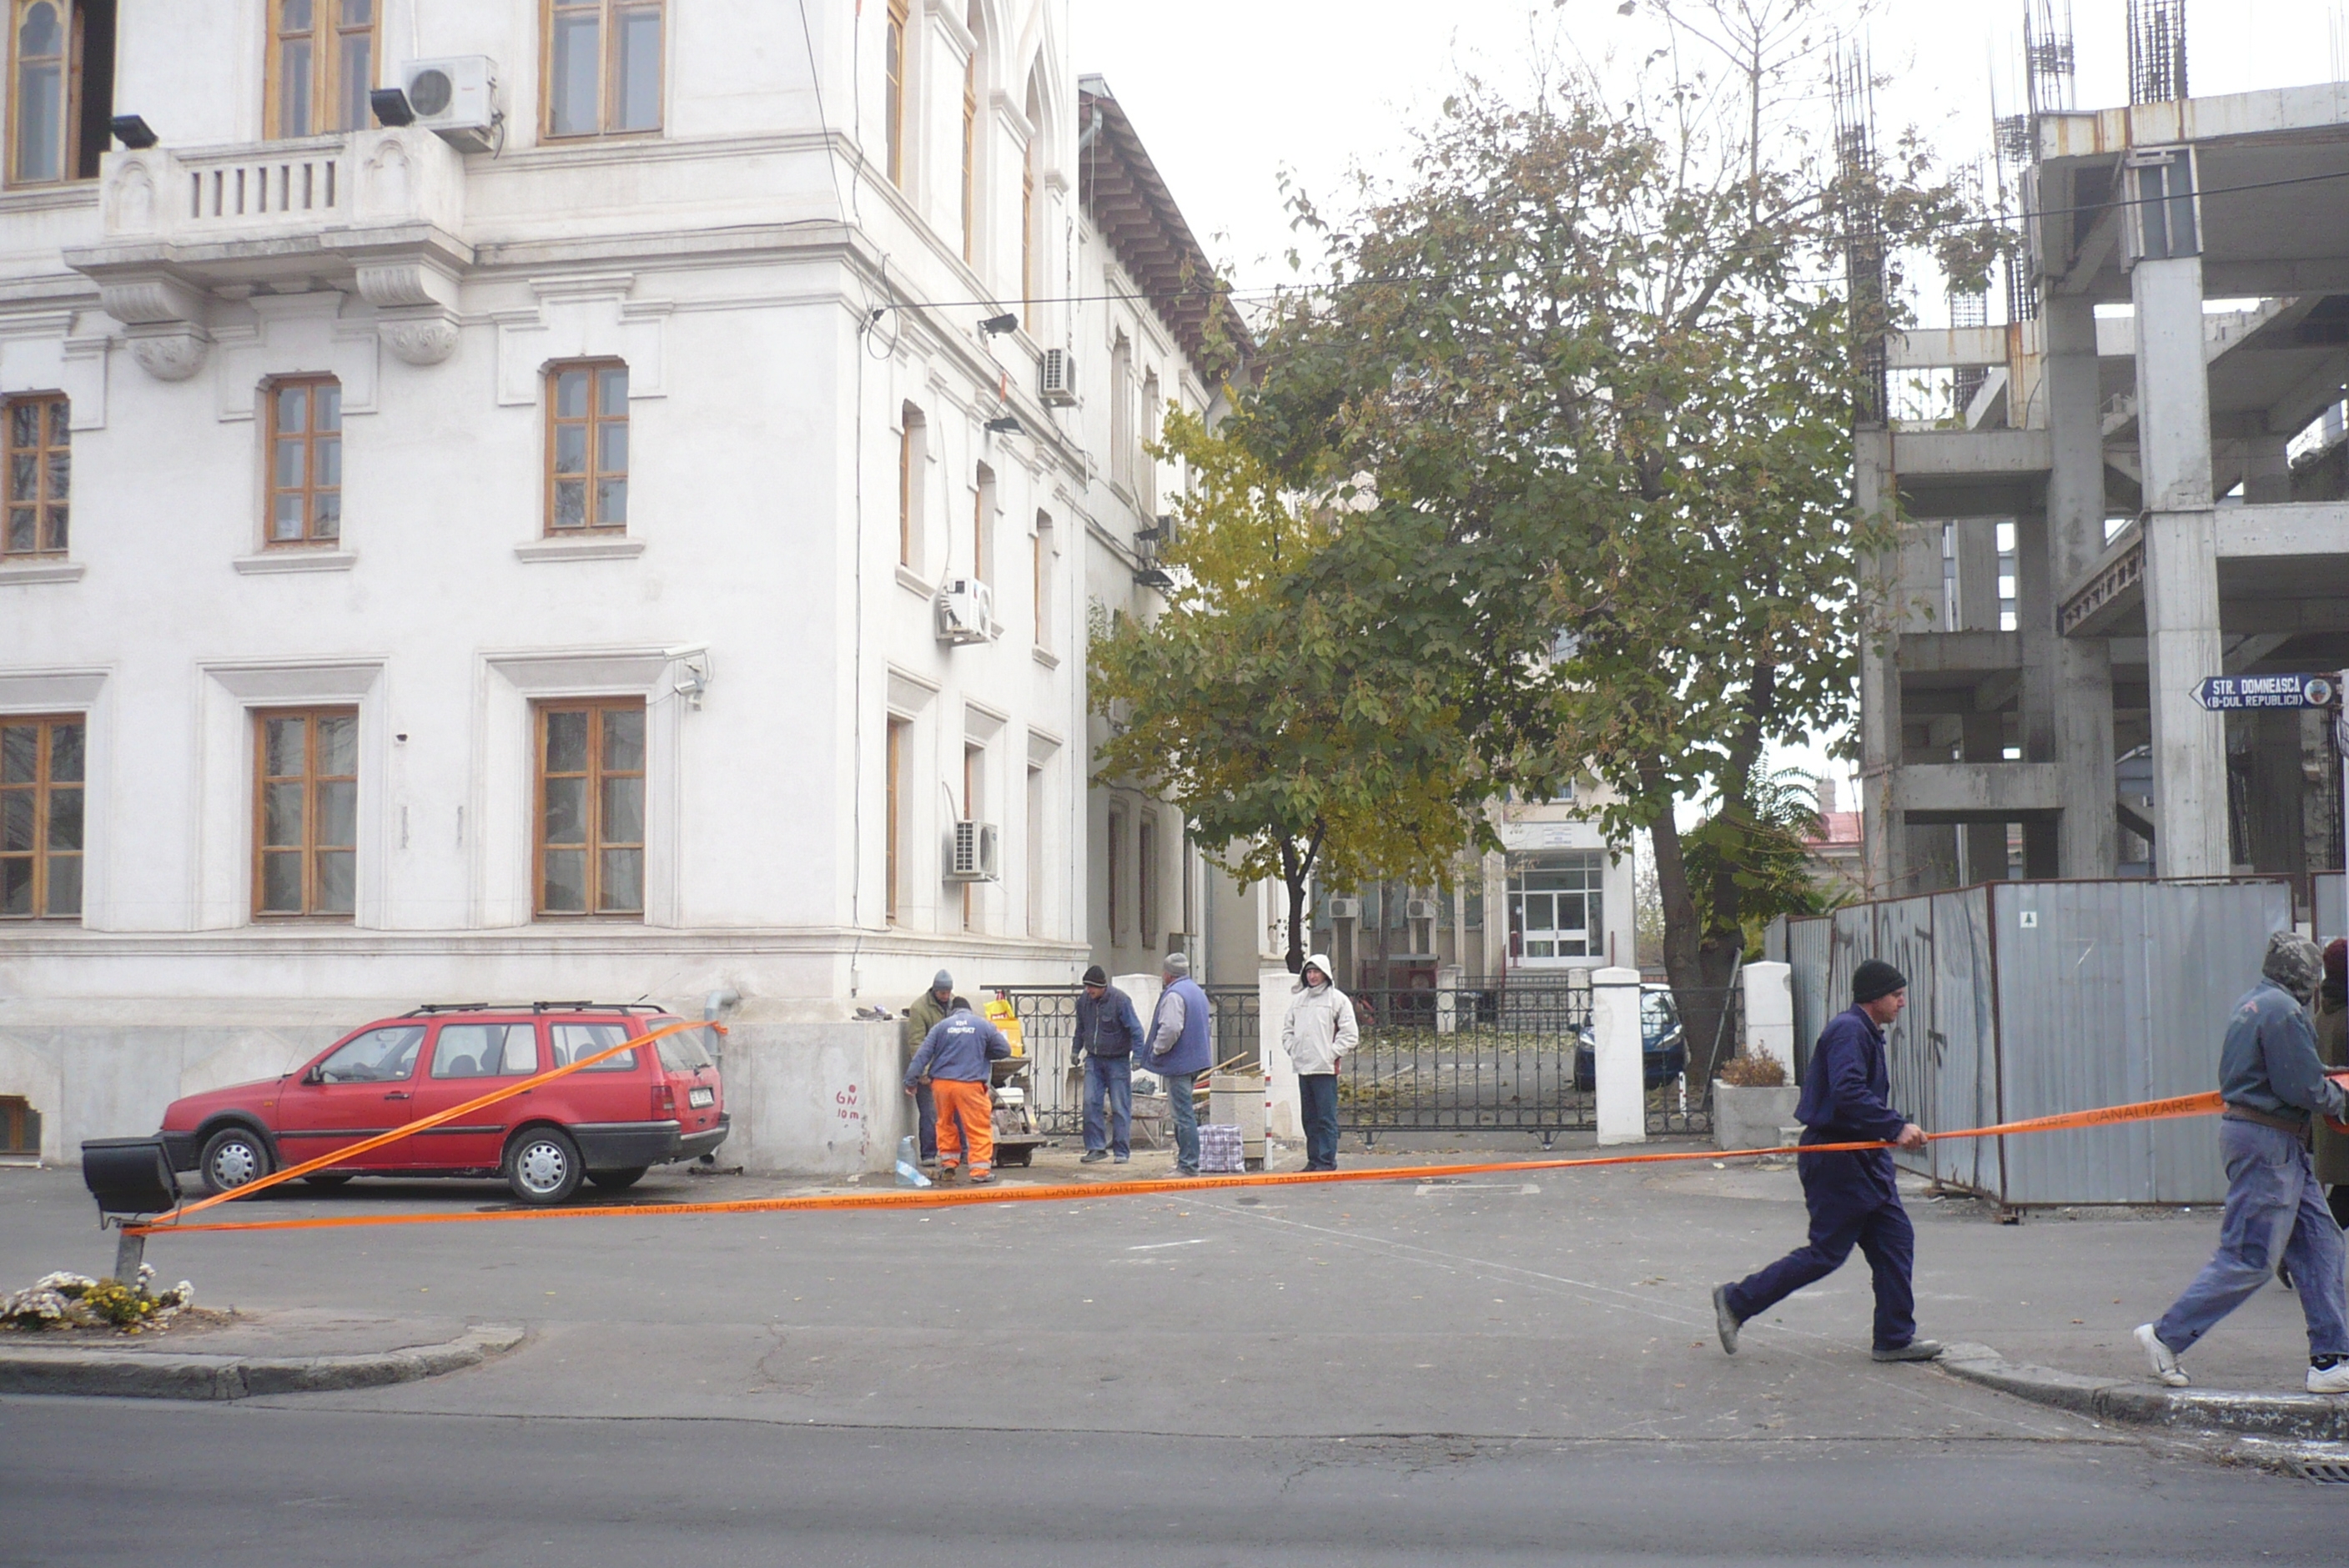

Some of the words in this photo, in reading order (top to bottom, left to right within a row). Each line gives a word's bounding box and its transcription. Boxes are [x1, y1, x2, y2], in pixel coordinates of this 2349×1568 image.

[2213, 680, 2236, 695] STR.
[2207, 697, 2242, 707] (B-DUL
[2246, 694, 2303, 706] REPUBLICII)
[2086, 1098, 2196, 1123] CANALIZARE
[727, 1200, 818, 1212] CANALIZARE
[1154, 1179, 1250, 1191] CANALIZARE
